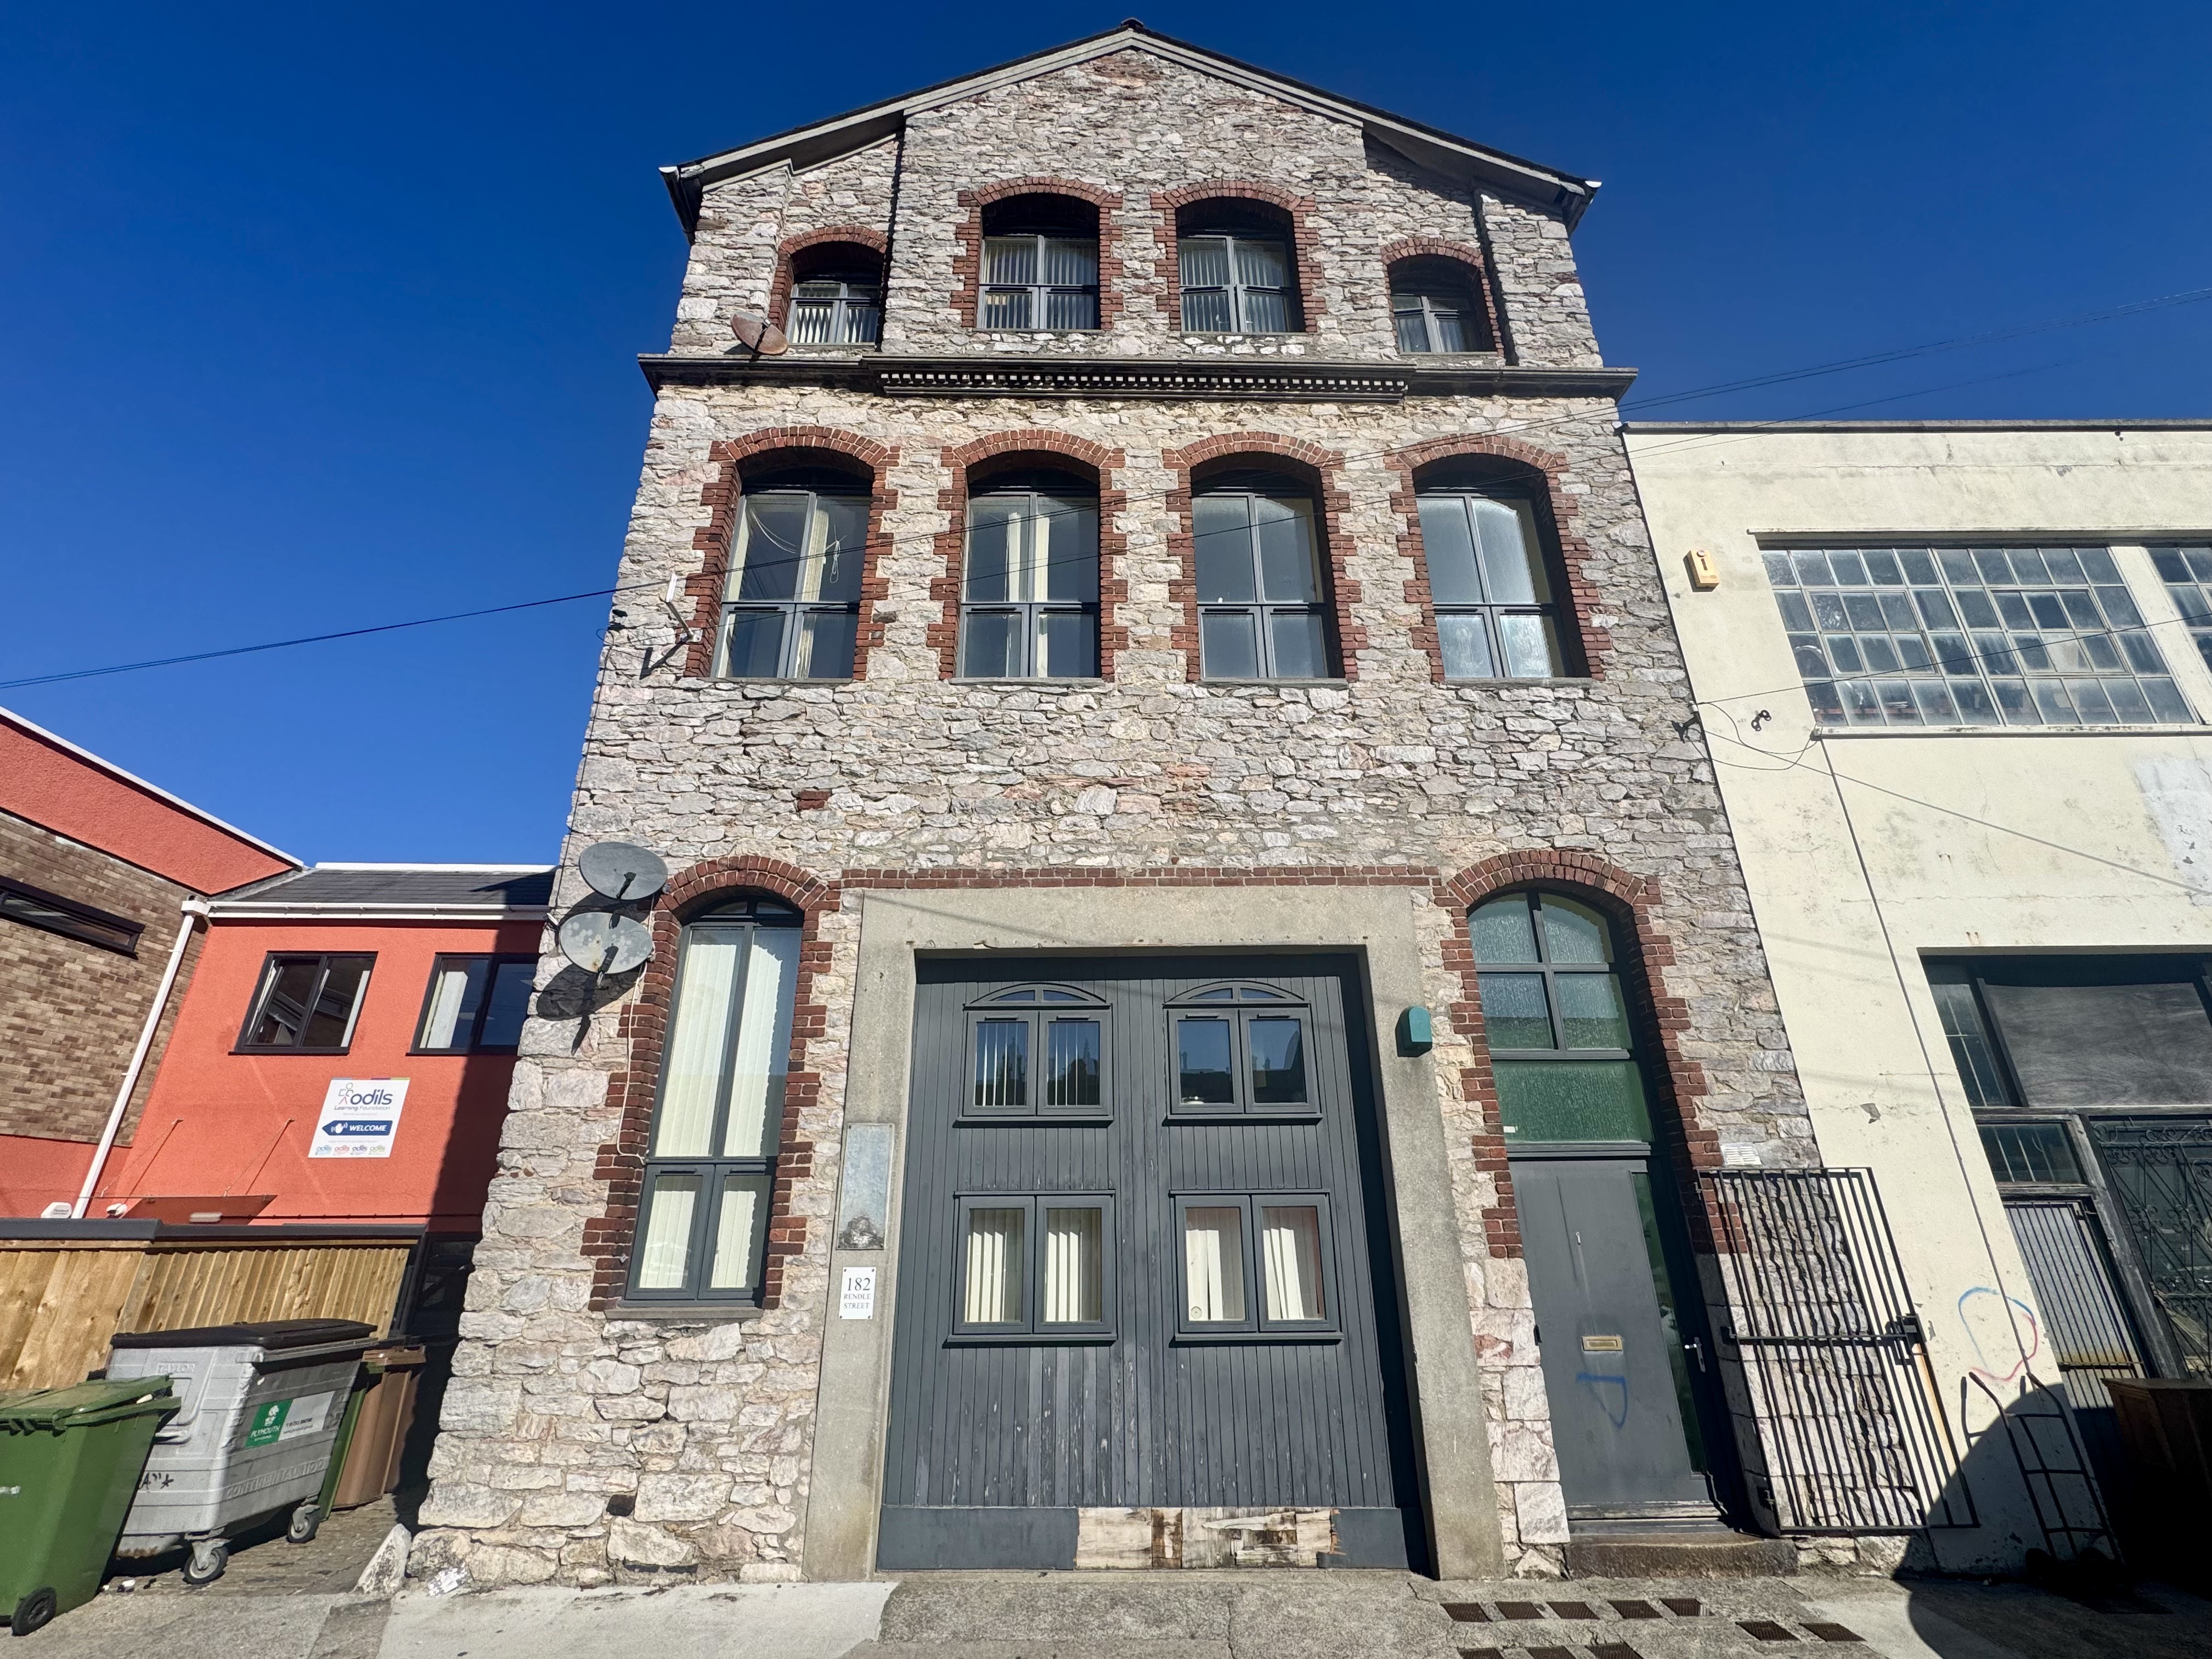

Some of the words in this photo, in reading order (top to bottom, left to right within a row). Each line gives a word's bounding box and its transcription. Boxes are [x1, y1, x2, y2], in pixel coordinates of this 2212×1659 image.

[350, 1088, 393, 1105] odils
[848, 1277, 871, 1291] 182
[250, 1425, 280, 1438] PLYMOUTH
[227, 1467, 298, 1498] CONTINENTAL
